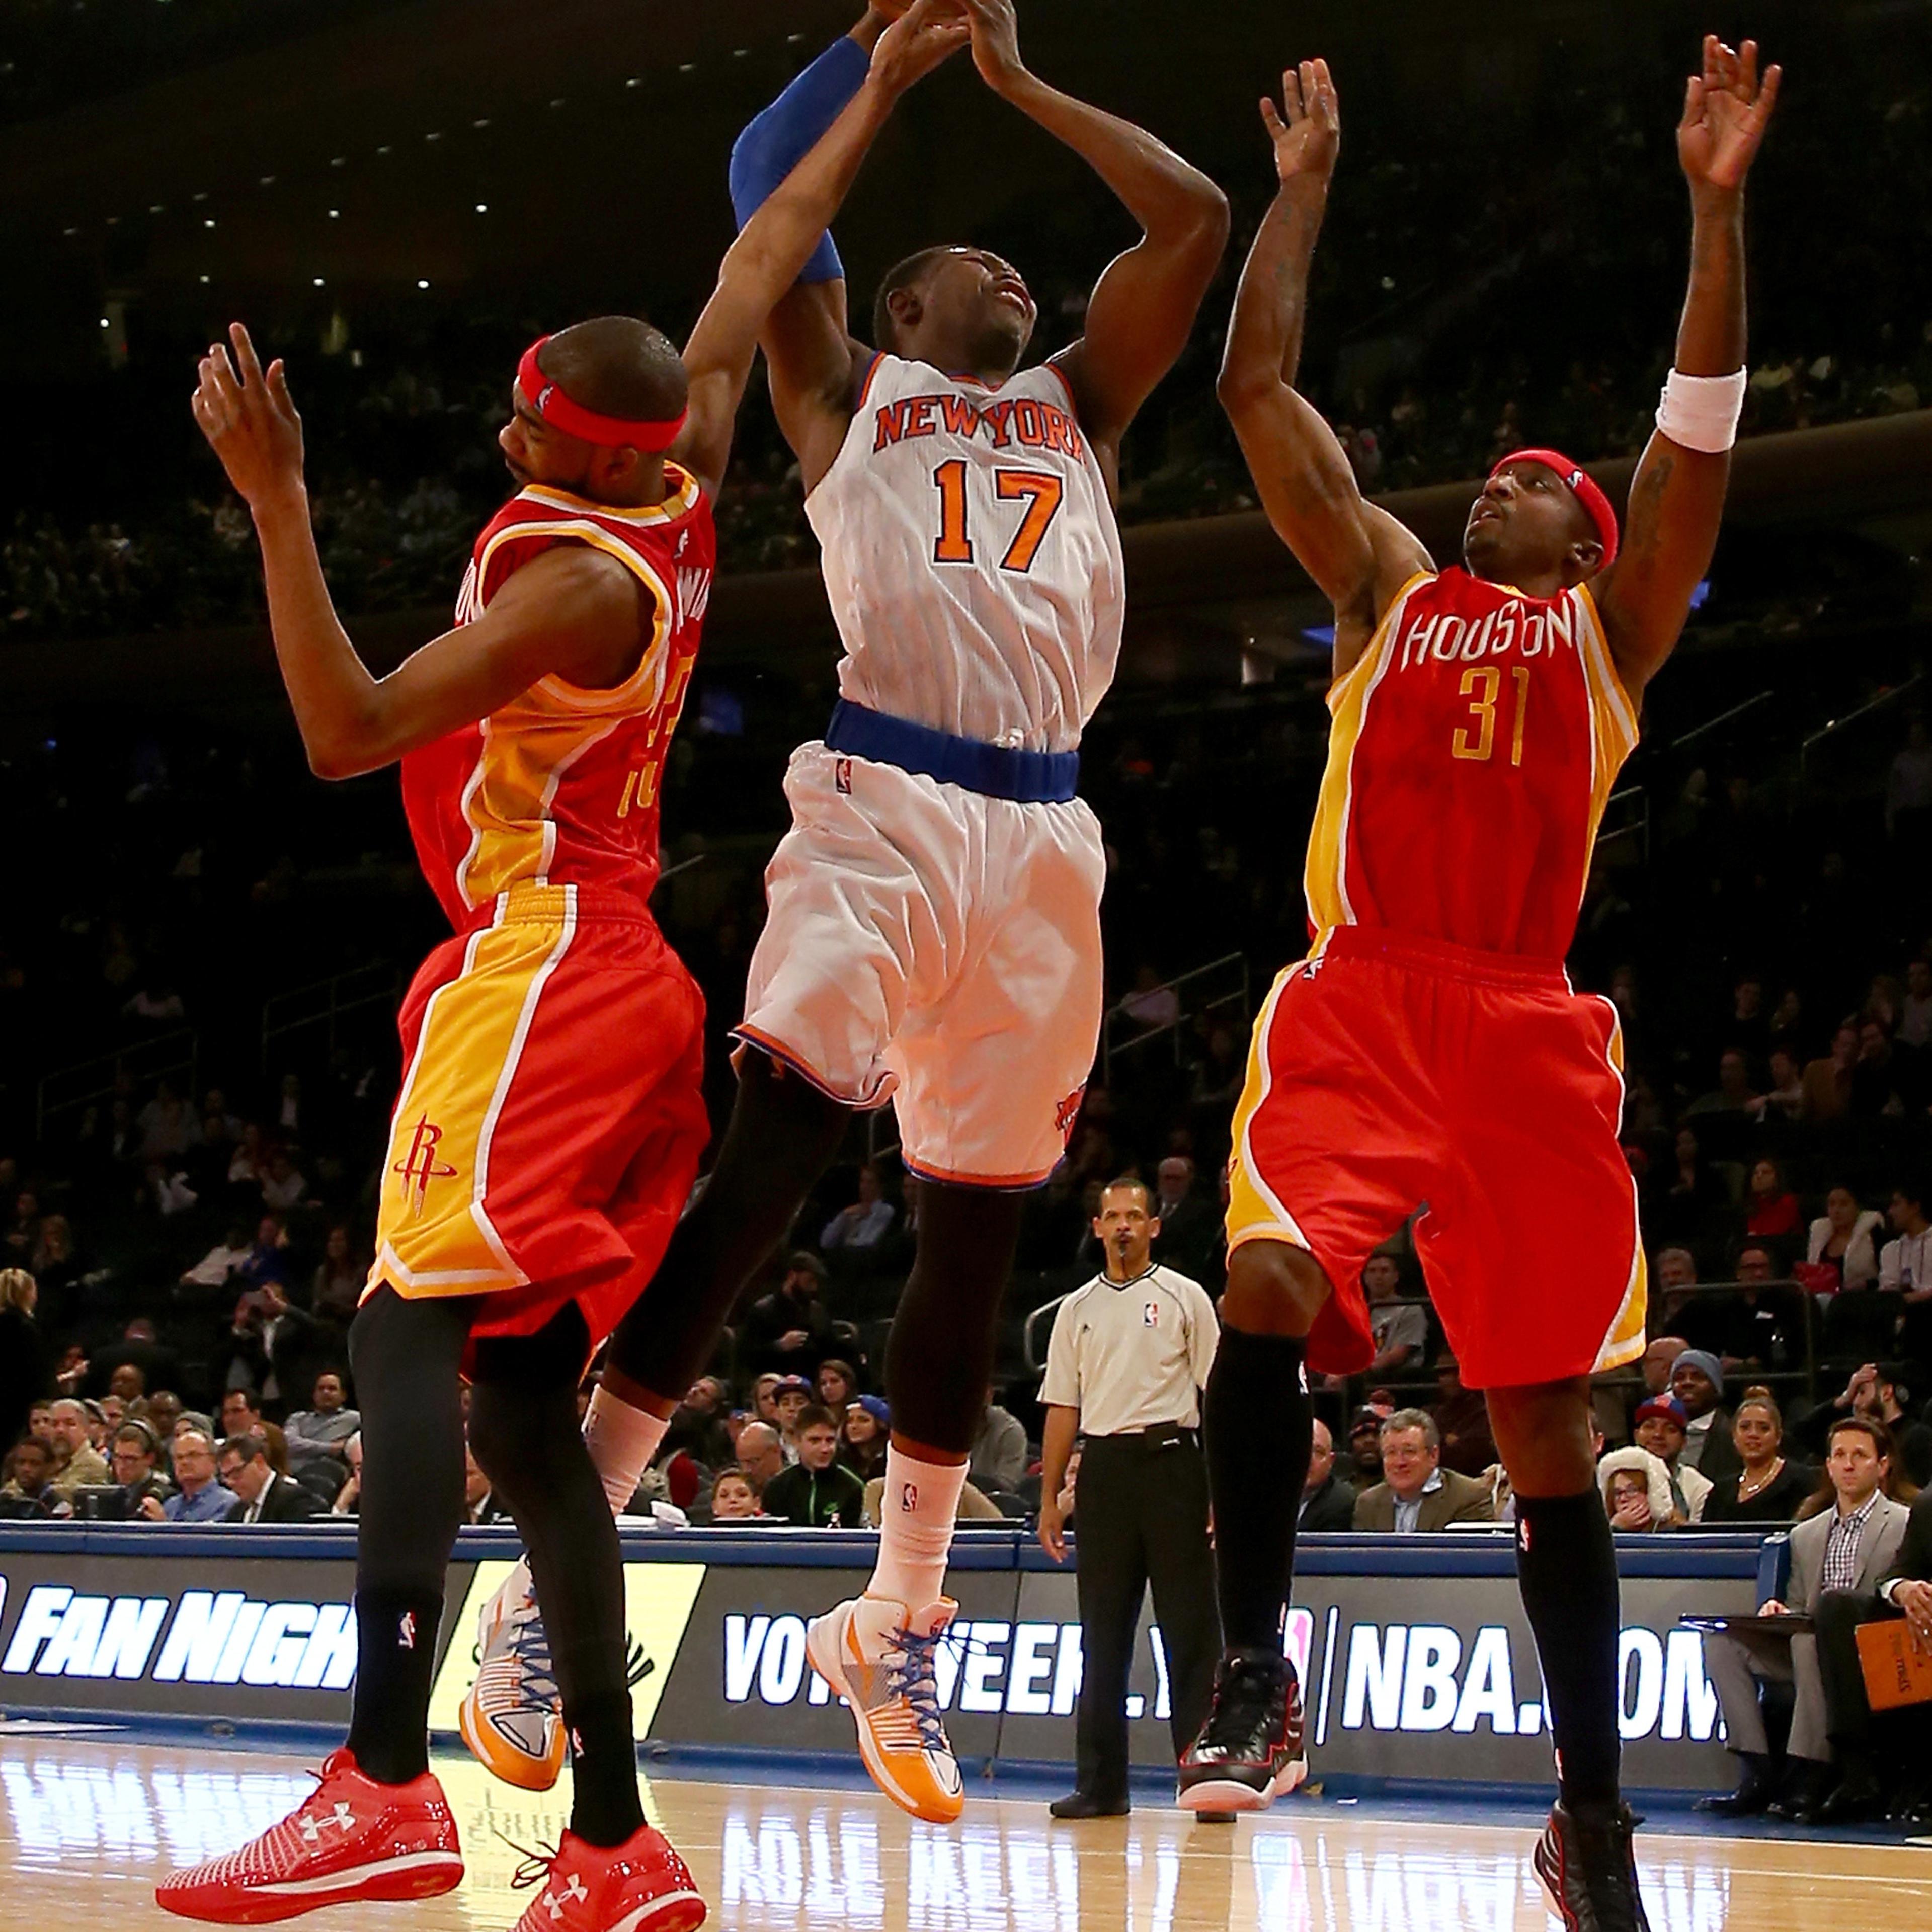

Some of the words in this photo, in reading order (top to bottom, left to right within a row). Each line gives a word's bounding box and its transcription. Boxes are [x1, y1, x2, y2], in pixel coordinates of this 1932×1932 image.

[873, 394, 980, 454] NEW
[933, 459, 1063, 574] 17
[1452, 665, 1530, 767] 31
[1, 1585, 171, 1680] FAN
[152, 1590, 359, 1691] NIGH
